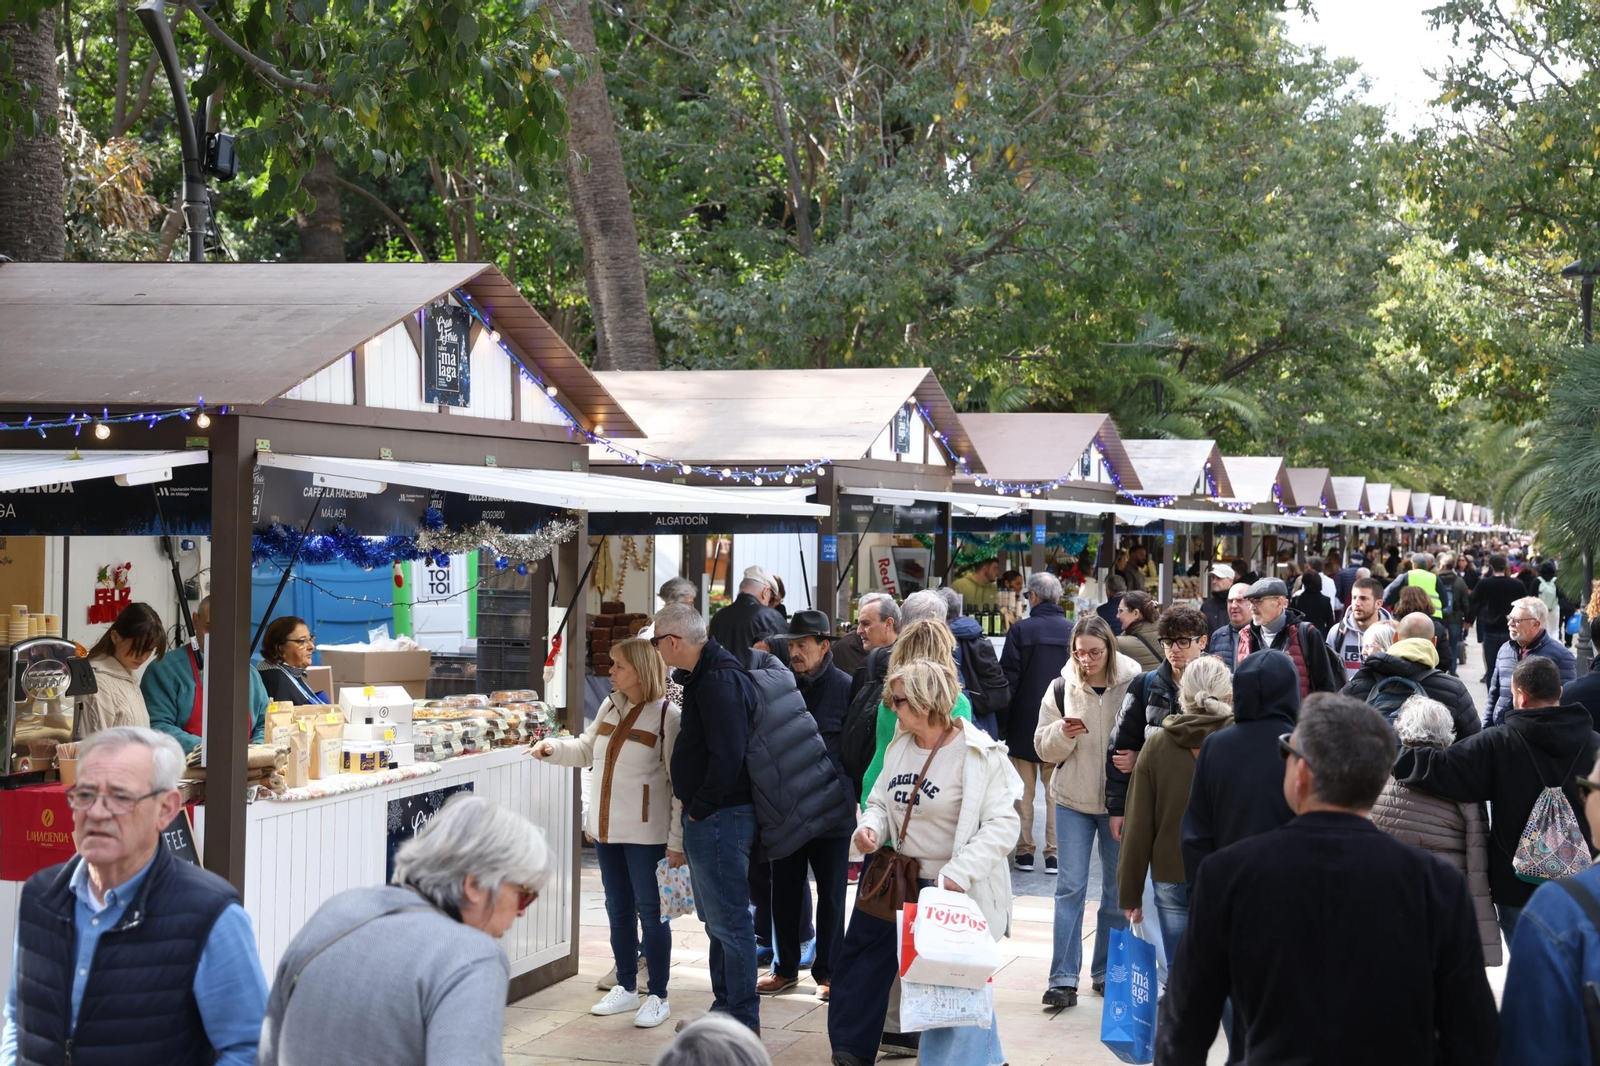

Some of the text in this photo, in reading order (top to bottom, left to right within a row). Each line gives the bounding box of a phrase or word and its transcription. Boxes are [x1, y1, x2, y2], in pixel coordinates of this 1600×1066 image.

[441, 348, 457, 367] má
[438, 359, 457, 383] laga
[320, 505, 347, 518] MÁLAGA
[481, 510, 506, 520] RIOGORDO
[655, 513, 709, 526] ALGATOCÍN
[428, 569, 450, 582] TOI
[428, 582, 450, 595] TOI
[893, 790, 920, 806] CLB
[924, 905, 987, 932] Tejeros
[1132, 971, 1150, 991] má
[1131, 984, 1150, 1005] aga
